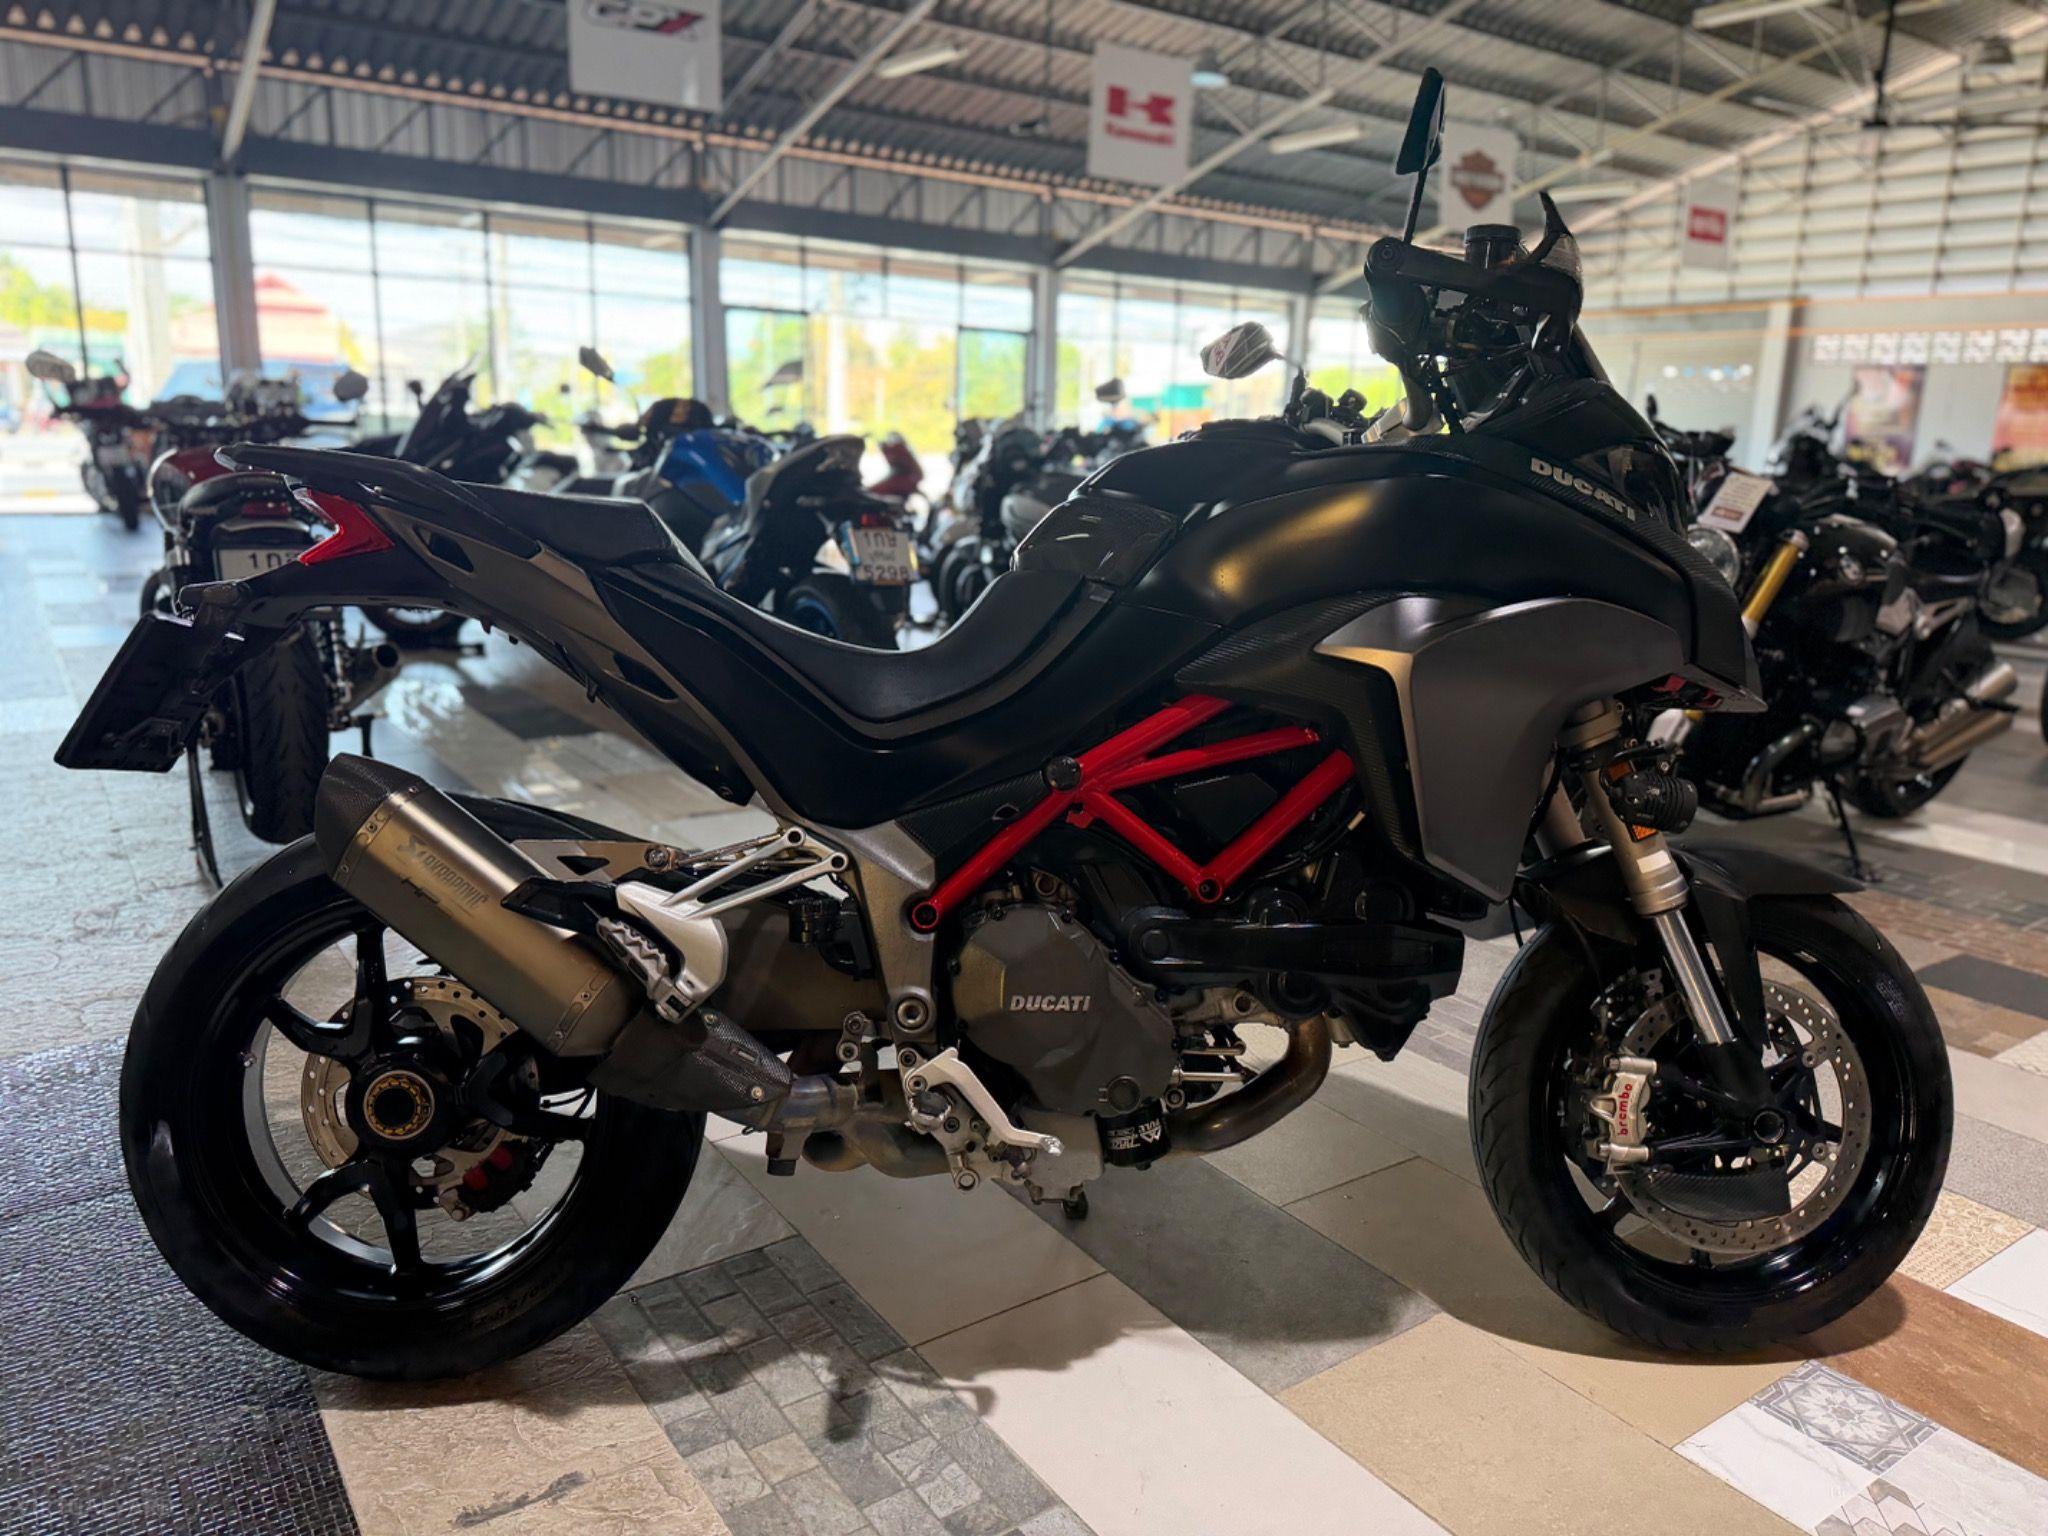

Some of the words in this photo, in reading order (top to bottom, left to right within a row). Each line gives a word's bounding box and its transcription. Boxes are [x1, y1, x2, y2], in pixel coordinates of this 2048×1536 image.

[1530, 457, 1636, 522] DUCATI
[1009, 994, 1091, 1012] DUCATI
[1618, 1083, 1633, 1136] brembo
